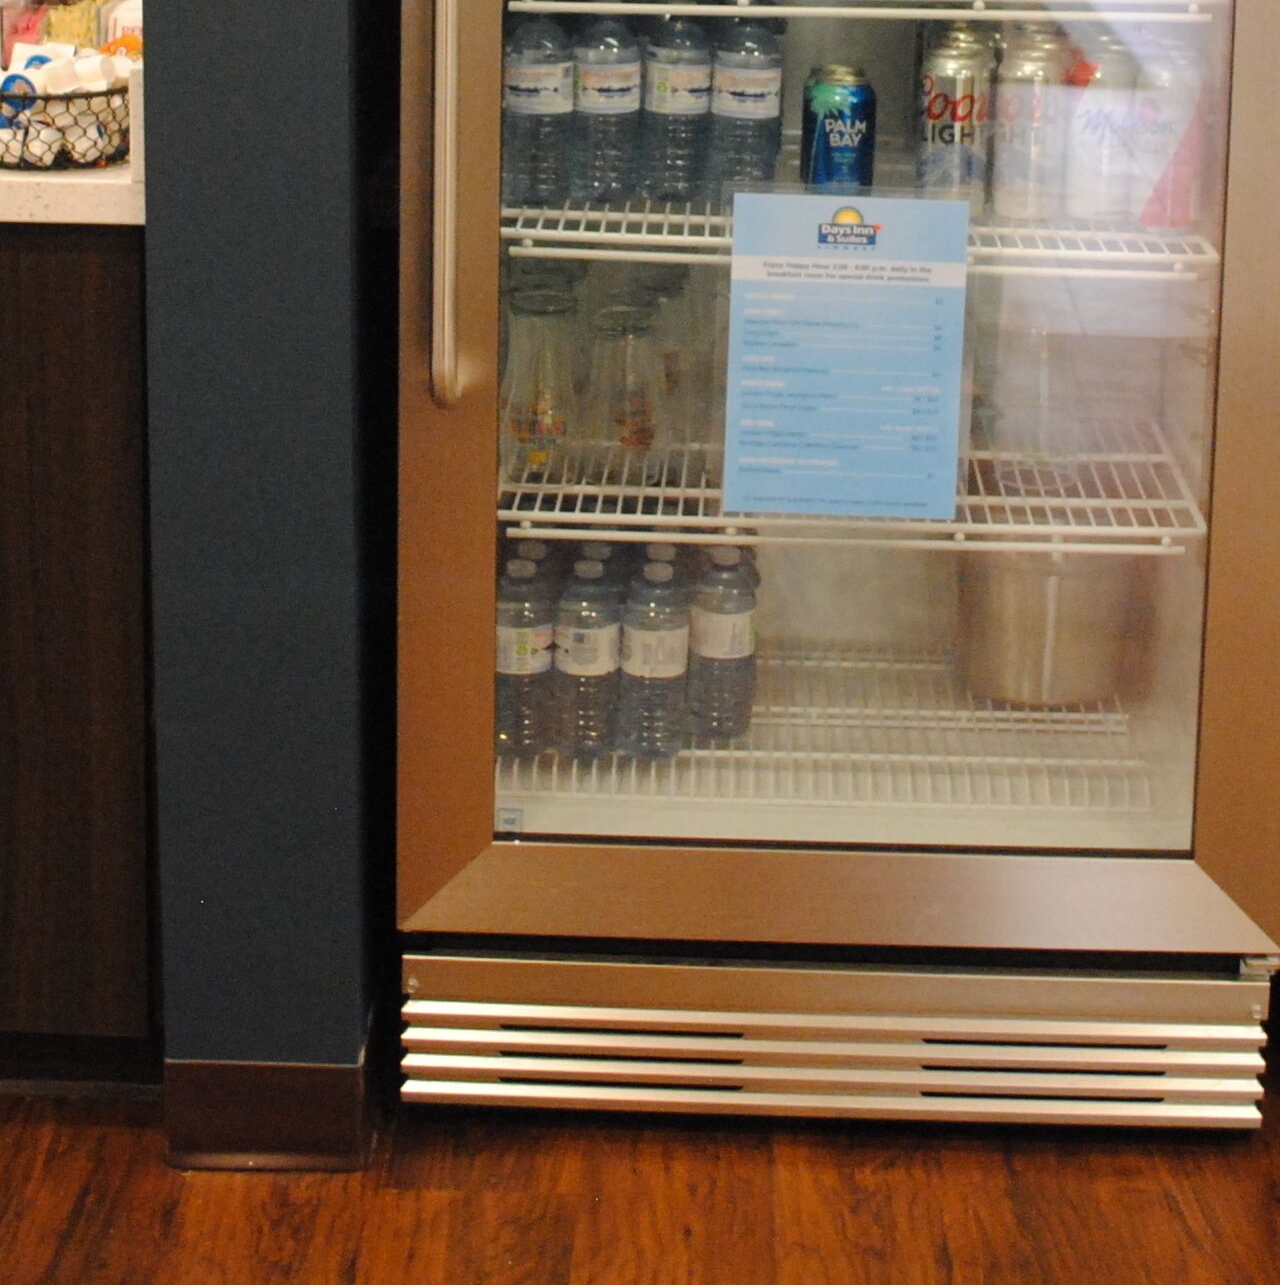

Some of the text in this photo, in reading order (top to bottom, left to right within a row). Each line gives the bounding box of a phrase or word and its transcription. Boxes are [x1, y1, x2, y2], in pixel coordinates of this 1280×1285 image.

[825, 118, 866, 133] PALM
[829, 133, 861, 147] BAY
[821, 224, 875, 236] Days Inn
